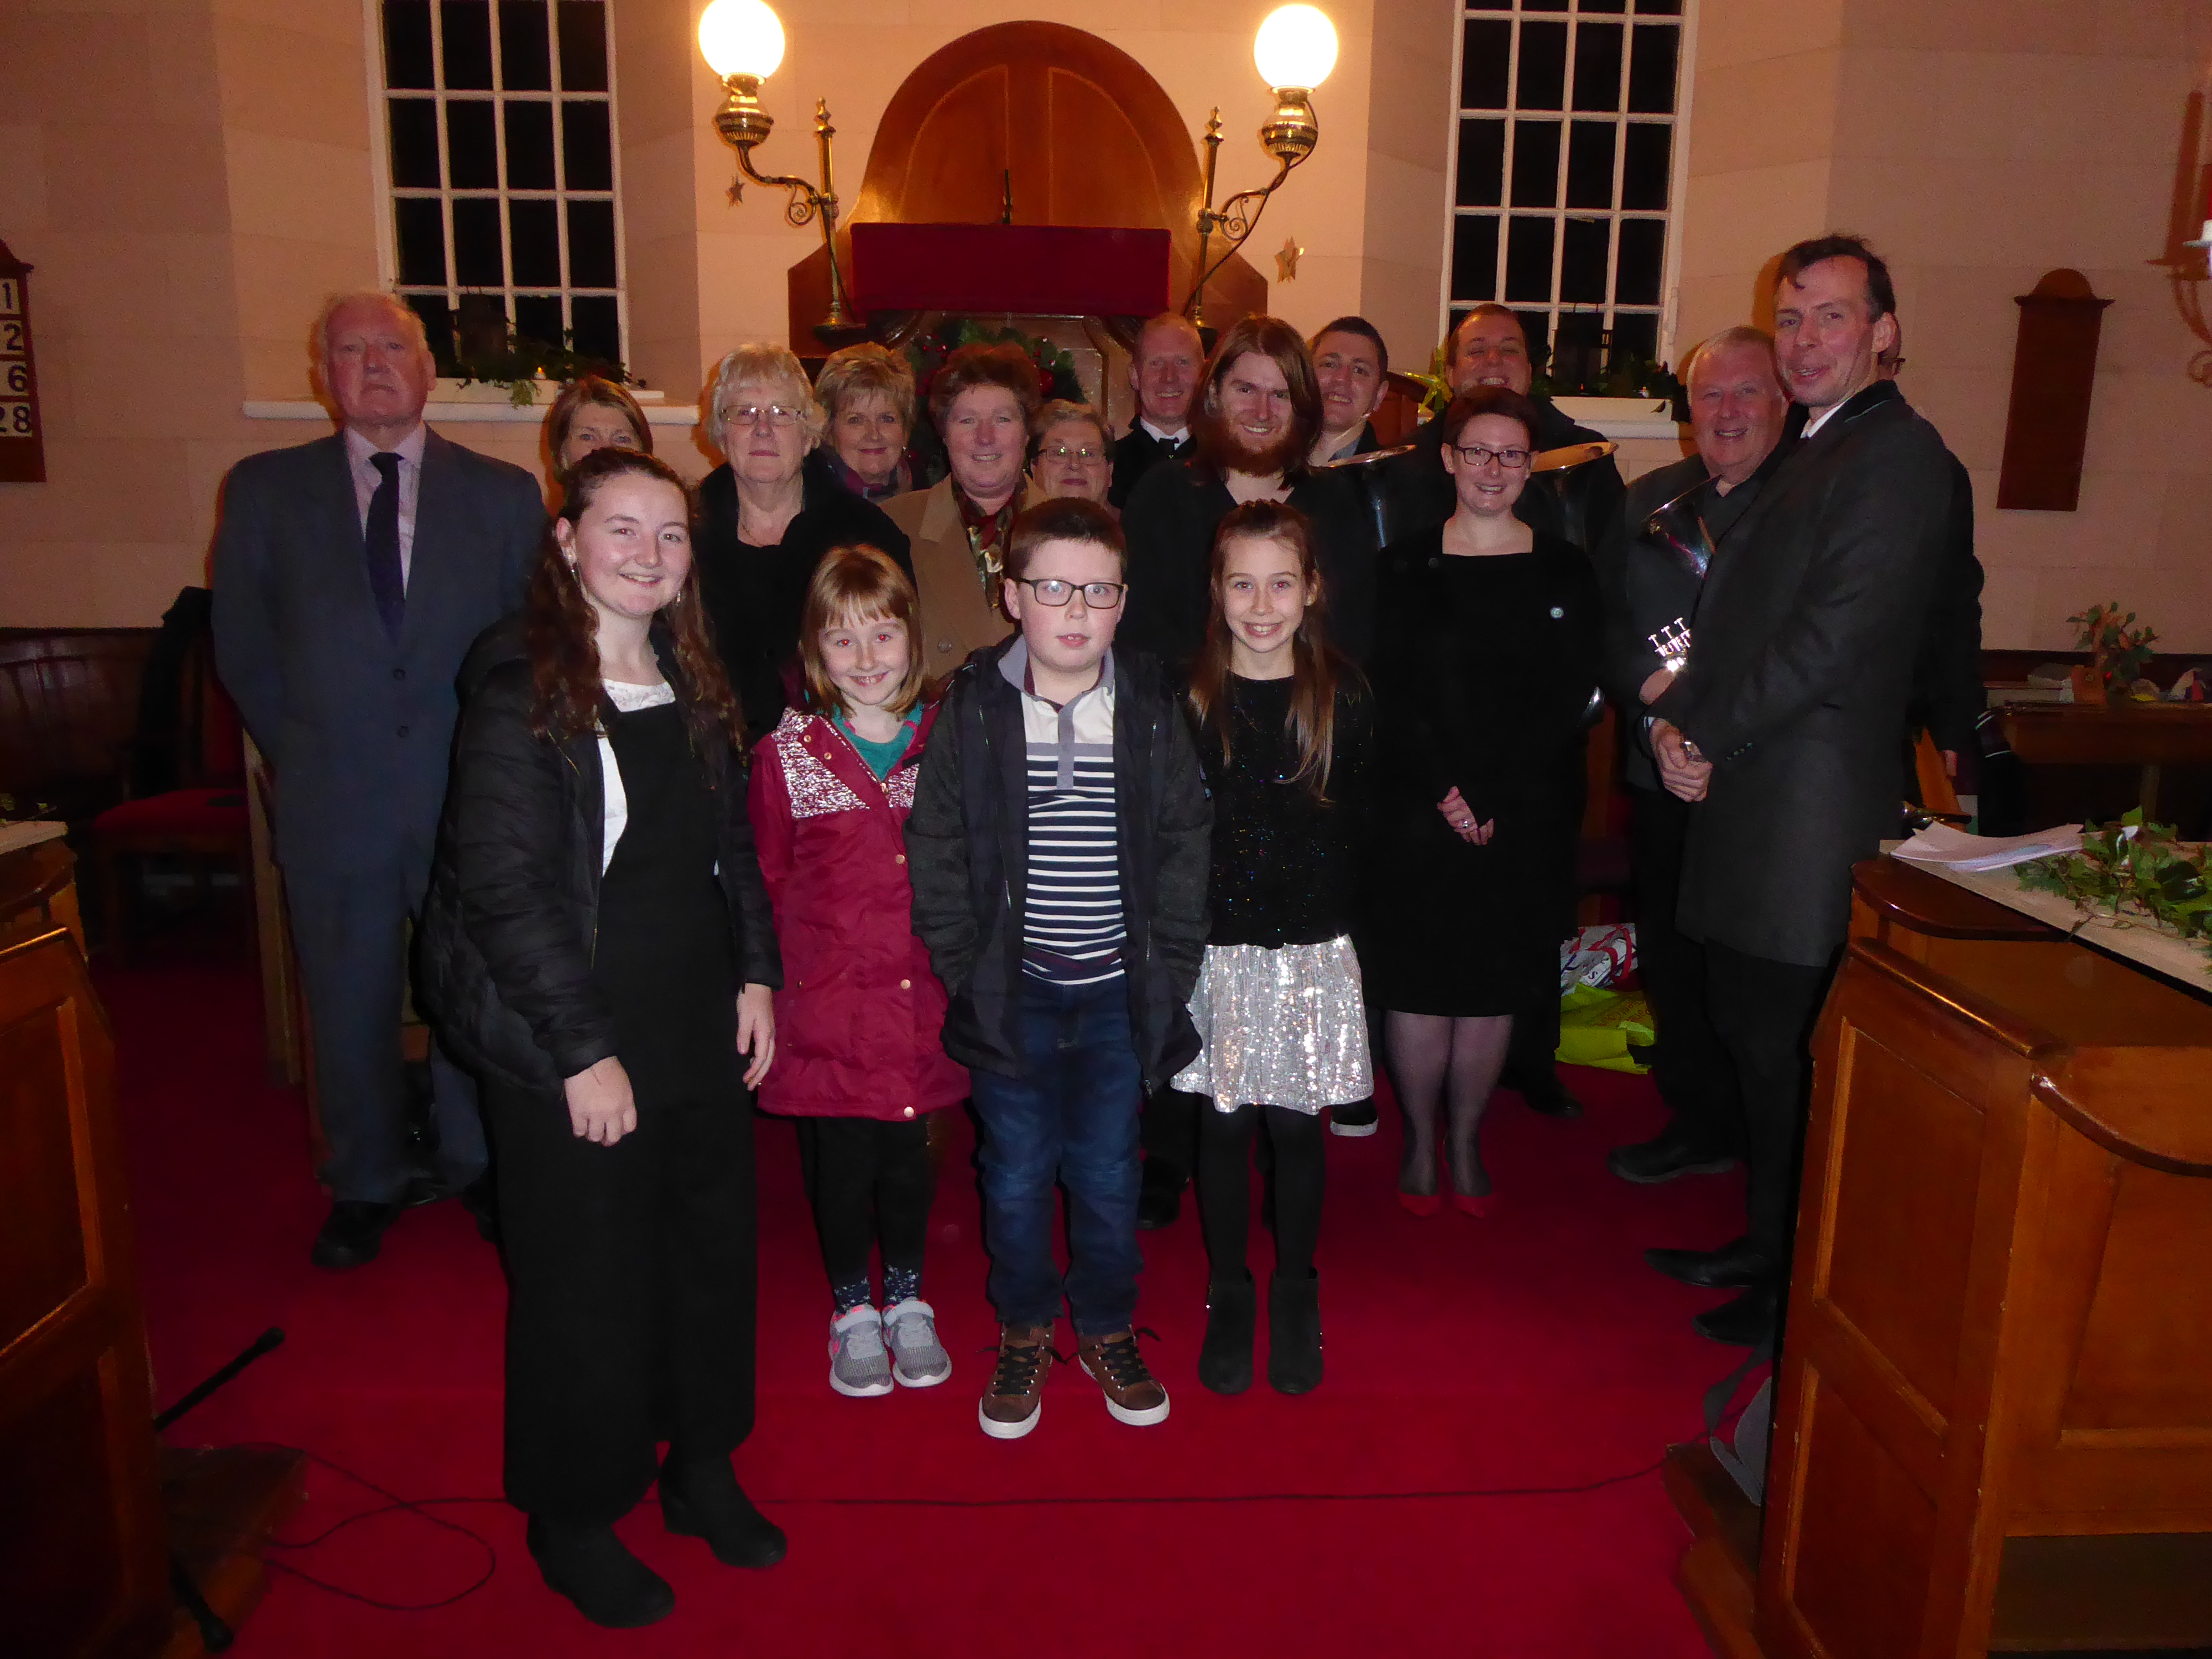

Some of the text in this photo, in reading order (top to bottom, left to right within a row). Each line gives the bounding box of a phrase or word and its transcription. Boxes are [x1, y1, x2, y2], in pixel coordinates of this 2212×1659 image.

[3, 283, 11, 309] 1
[4, 324, 22, 350] 2
[8, 365, 26, 392] 6
